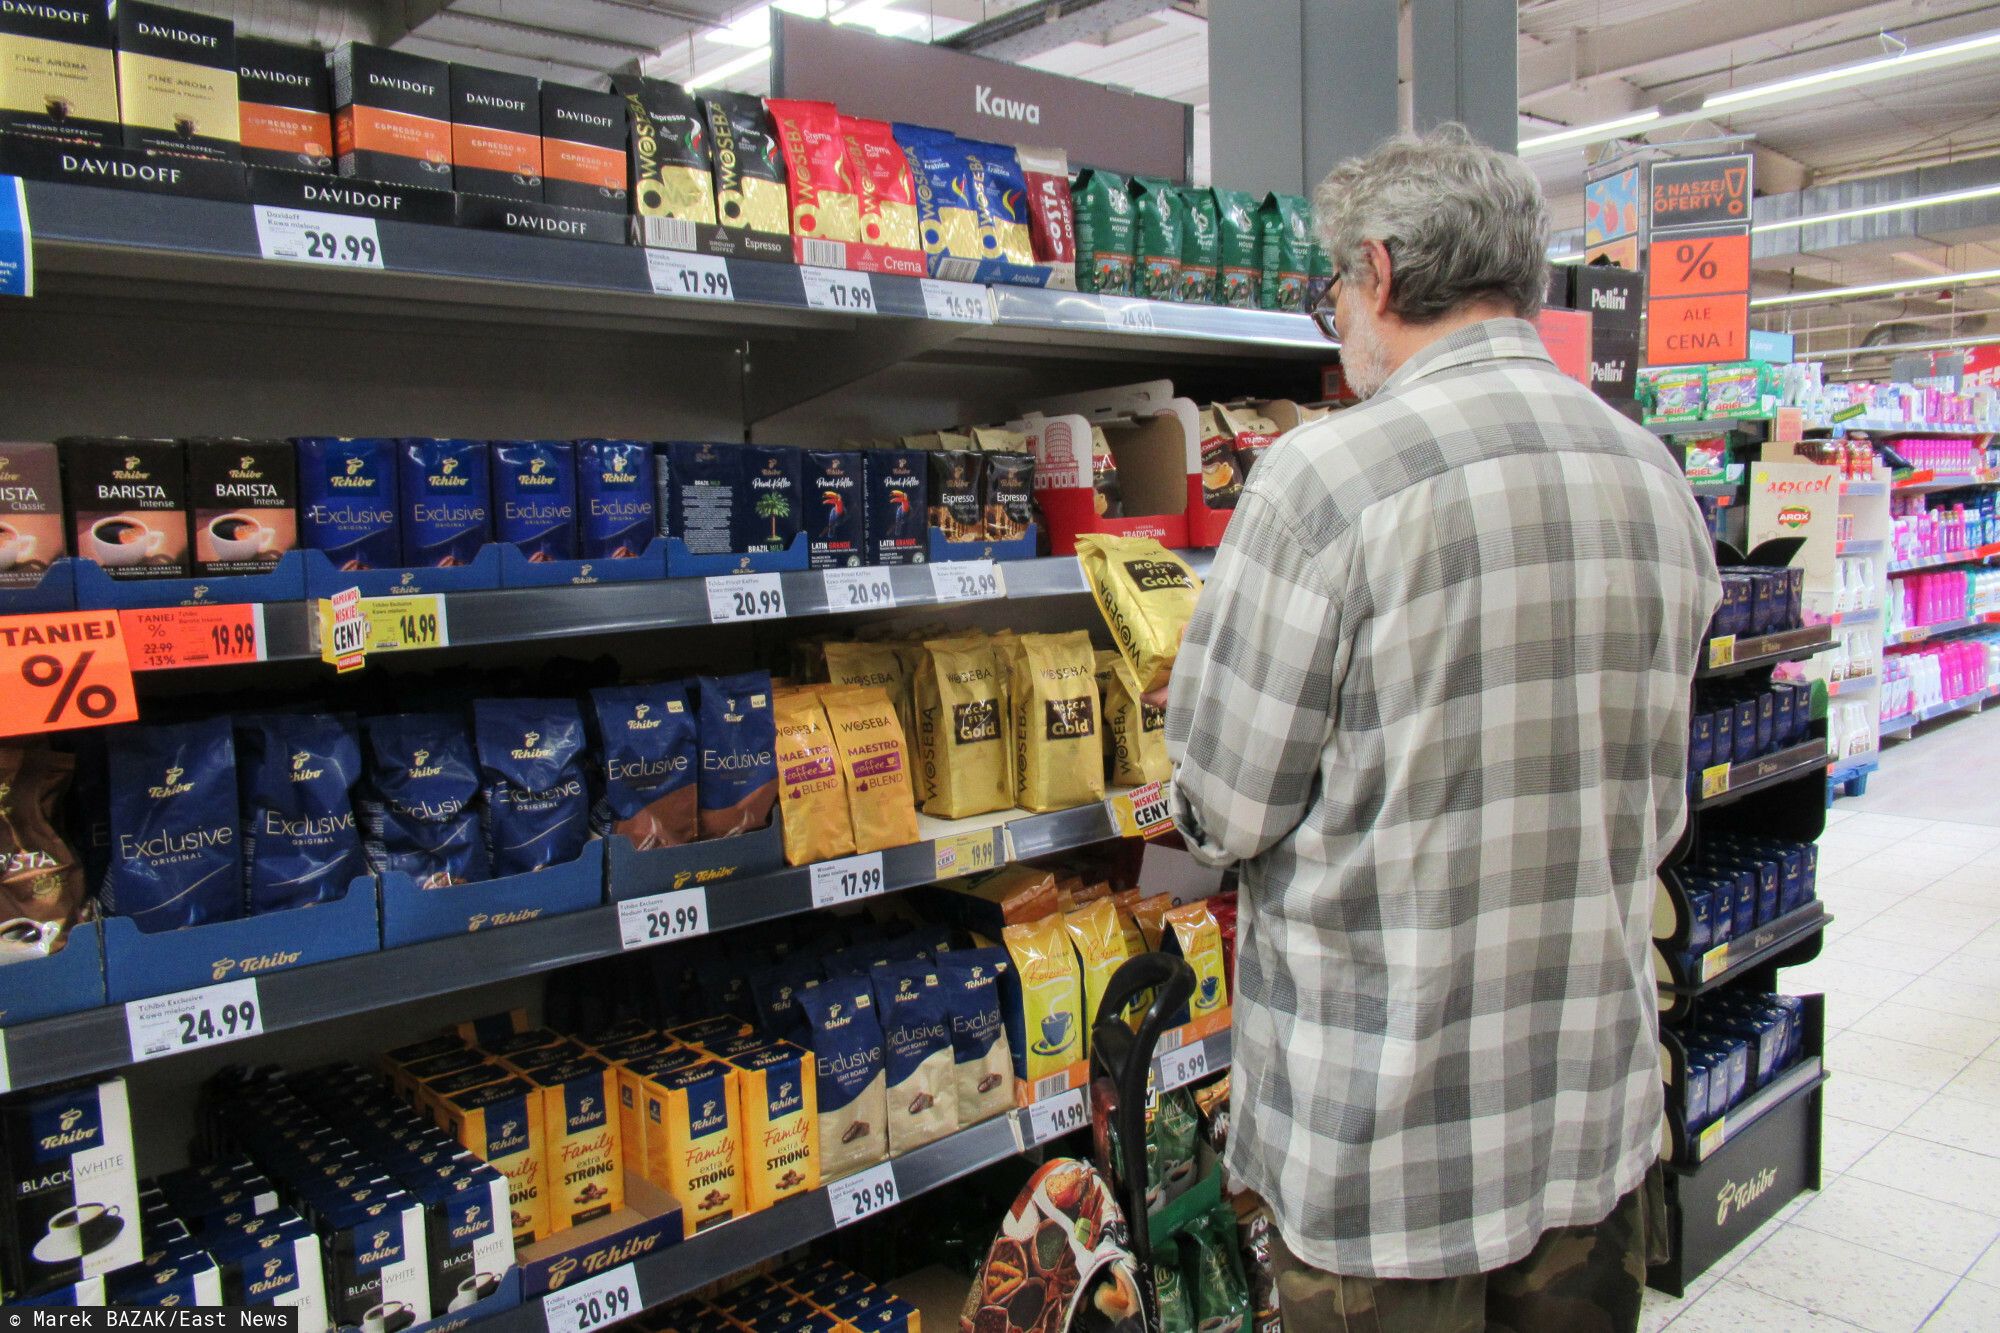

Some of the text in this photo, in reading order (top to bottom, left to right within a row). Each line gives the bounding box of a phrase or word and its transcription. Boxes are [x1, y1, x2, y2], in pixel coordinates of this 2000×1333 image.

[2, 2, 90, 24] DAVIDOFF
[138, 22, 219, 49] DAVIDOFF
[47, 59, 87, 71] AROMA
[176, 78, 215, 91] AROMA
[240, 66, 312, 87] DAVIDOFF
[369, 73, 436, 96] DAVIDOFF
[466, 92, 526, 112] DAVIDOFF
[975, 85, 1041, 125] Kawa
[556, 108, 613, 128] DAVIDOFF
[26, 123, 91, 137] GROUND COFFEE
[803, 129, 832, 143] Crema
[156, 139, 213, 154] GROUND COFFEE
[709, 101, 738, 190] WOSEBA
[864, 143, 891, 156] Crema
[62, 155, 182, 184] DAVIDOFF
[304, 185, 402, 210] DAVIDOFF
[1654, 184, 1664, 198] Z
[1654, 194, 1725, 213] OFERTY
[506, 212, 588, 236] DAVIDOFF
[1042, 180, 1064, 256] COSTA
[304, 231, 376, 262] 29.99
[745, 237, 782, 252] Espresso
[884, 255, 922, 273] Crema
[1676, 243, 1718, 283] %
[679, 270, 728, 296] 17.99
[1012, 273, 1040, 284] Arabica
[829, 284, 871, 309] 17.99
[1591, 288, 1628, 310] Pellini
[946, 297, 984, 318] 16.99
[1684, 308, 1711, 321] ALE
[1667, 334, 1720, 350] CENA
[1591, 361, 1626, 382] Pellini
[216, 483, 278, 498] BARISTA
[331, 475, 375, 488] Tchibo
[98, 485, 166, 499] BARISTA
[254, 497, 285, 506] Intense
[942, 493, 975, 503] Espresso
[997, 492, 1028, 503] Espresso
[11, 502, 46, 511] Classic
[139, 500, 175, 509] Intense
[315, 504, 393, 525] Exclusive
[414, 503, 485, 522] Exclusive
[505, 501, 572, 520] Exclusive
[591, 499, 652, 517] Exclusive
[811, 542, 828, 550] LATIN
[879, 539, 895, 547] LATIN
[958, 574, 996, 594] 22.99
[1142, 574, 1184, 587] Gold
[733, 590, 781, 616] 20.99
[848, 582, 890, 605] 20.99
[138, 614, 174, 623] TANIEJ
[400, 614, 436, 643] 14.99
[0, 620, 116, 646] TANIEJ
[148, 624, 166, 637] %
[211, 623, 254, 656] 19.99
[334, 621, 361, 651] CENY
[144, 656, 176, 666] -13%
[842, 673, 894, 686] WOSEBA
[947, 669, 992, 683] WOSEBA
[21, 651, 117, 723] %
[959, 705, 992, 716] MOCCA
[627, 719, 662, 730] Tchibo
[841, 716, 892, 732] WOSEBA
[961, 723, 995, 740] Gold
[1053, 720, 1088, 735] Gold
[848, 740, 898, 756] MAESTRO
[1115, 705, 1131, 775] WOSEBA
[704, 749, 771, 770] Exclusive
[922, 706, 937, 800] WOSEBA
[608, 755, 688, 781] Exclusive
[787, 764, 818, 782] coffee
[855, 760, 885, 776] coffee
[148, 782, 195, 798] Tchibo
[802, 780, 838, 795] BLEND
[869, 775, 903, 788] BLEND
[517, 802, 558, 811] ORIGINAL
[1135, 800, 1169, 826] CENY
[120, 825, 233, 861] Exclusive
[292, 836, 334, 846] ORIGINAL
[151, 853, 203, 866] ORIGINAL
[972, 842, 992, 866] 19.99
[841, 868, 880, 897] 17.99
[647, 906, 698, 938] 29.99
[240, 951, 302, 973] Tchibo
[138, 995, 204, 1012] Tchibo Exclusive
[139, 1005, 195, 1020] Kawa mielona
[179, 1001, 255, 1044] 24.99
[953, 1009, 1001, 1033] Exclusi
[818, 1047, 881, 1076] Exclusive
[1177, 1055, 1205, 1080] 8.99
[850, 1067, 869, 1077] ROAST
[770, 1096, 800, 1112] Tchibo
[692, 1115, 725, 1131] Tchibo
[1051, 1104, 1084, 1132] 14.99
[40, 1126, 98, 1150] Tchibo
[763, 1117, 810, 1148] Family
[562, 1132, 614, 1157] Family
[685, 1137, 735, 1168] Family
[777, 1142, 798, 1154] extra
[576, 1155, 601, 1168] extra
[767, 1145, 810, 1170] STRONG
[21, 1155, 124, 1194] BLACK WHITE
[564, 1160, 613, 1185] STRONG
[689, 1165, 735, 1191] STRONG
[700, 1162, 724, 1174] extra
[852, 1179, 894, 1215] 29.99
[1735, 1167, 1778, 1212] Tchibo
[452, 1219, 490, 1238] Tchibo
[359, 1246, 400, 1264] Tchibo
[443, 1239, 504, 1268] BLACK WHITE
[582, 1231, 663, 1274] Tchibo
[249, 1273, 294, 1295] Tchibo
[348, 1266, 415, 1296] BLACK WHITE
[575, 1286, 629, 1329] 20.99
